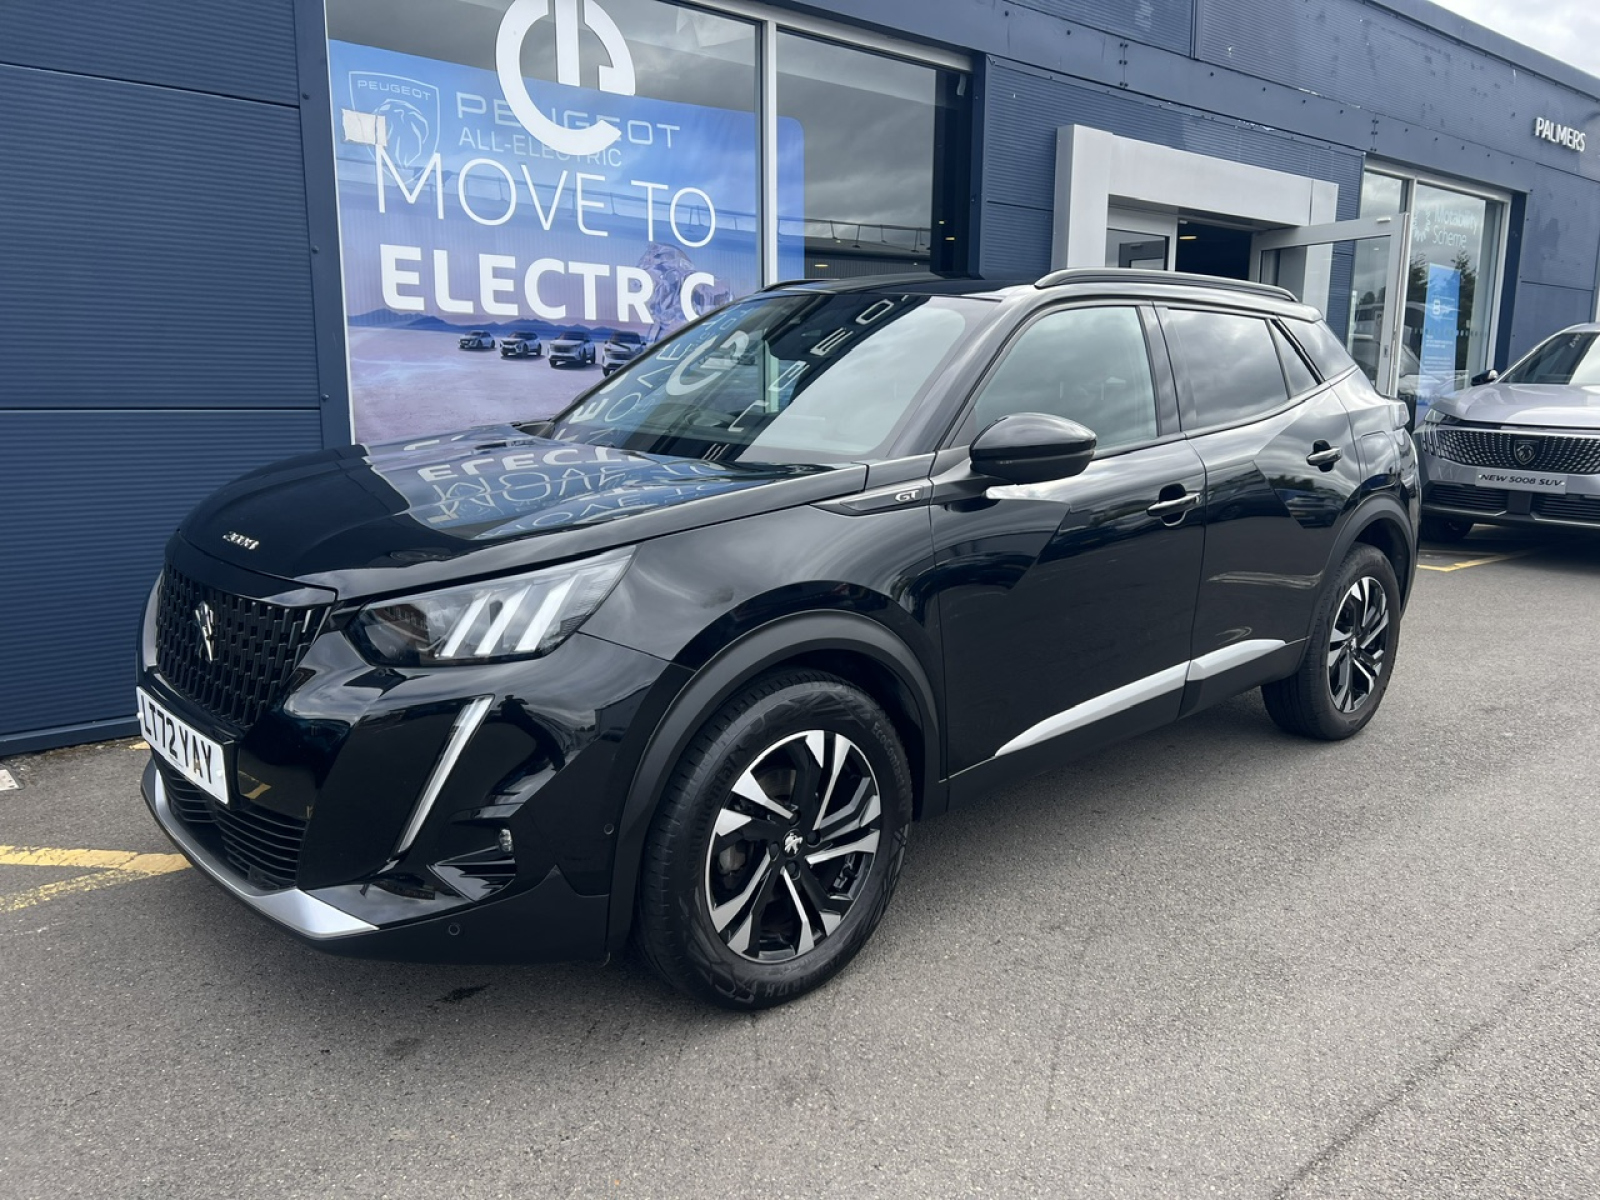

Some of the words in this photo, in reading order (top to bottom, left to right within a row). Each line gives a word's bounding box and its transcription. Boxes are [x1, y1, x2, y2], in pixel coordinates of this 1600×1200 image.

[357, 79, 431, 101] PEUGEOT
[1534, 116, 1586, 152] PALMERS
[374, 144, 609, 237] MOVE
[630, 180, 716, 247] TO
[1434, 203, 1477, 236] Motability
[1432, 225, 1467, 250] Scheme
[1480, 474, 1508, 482] NEW
[1509, 475, 1536, 485] 5008
[1538, 478, 1562, 486] SUV
[895, 490, 920, 502] GT
